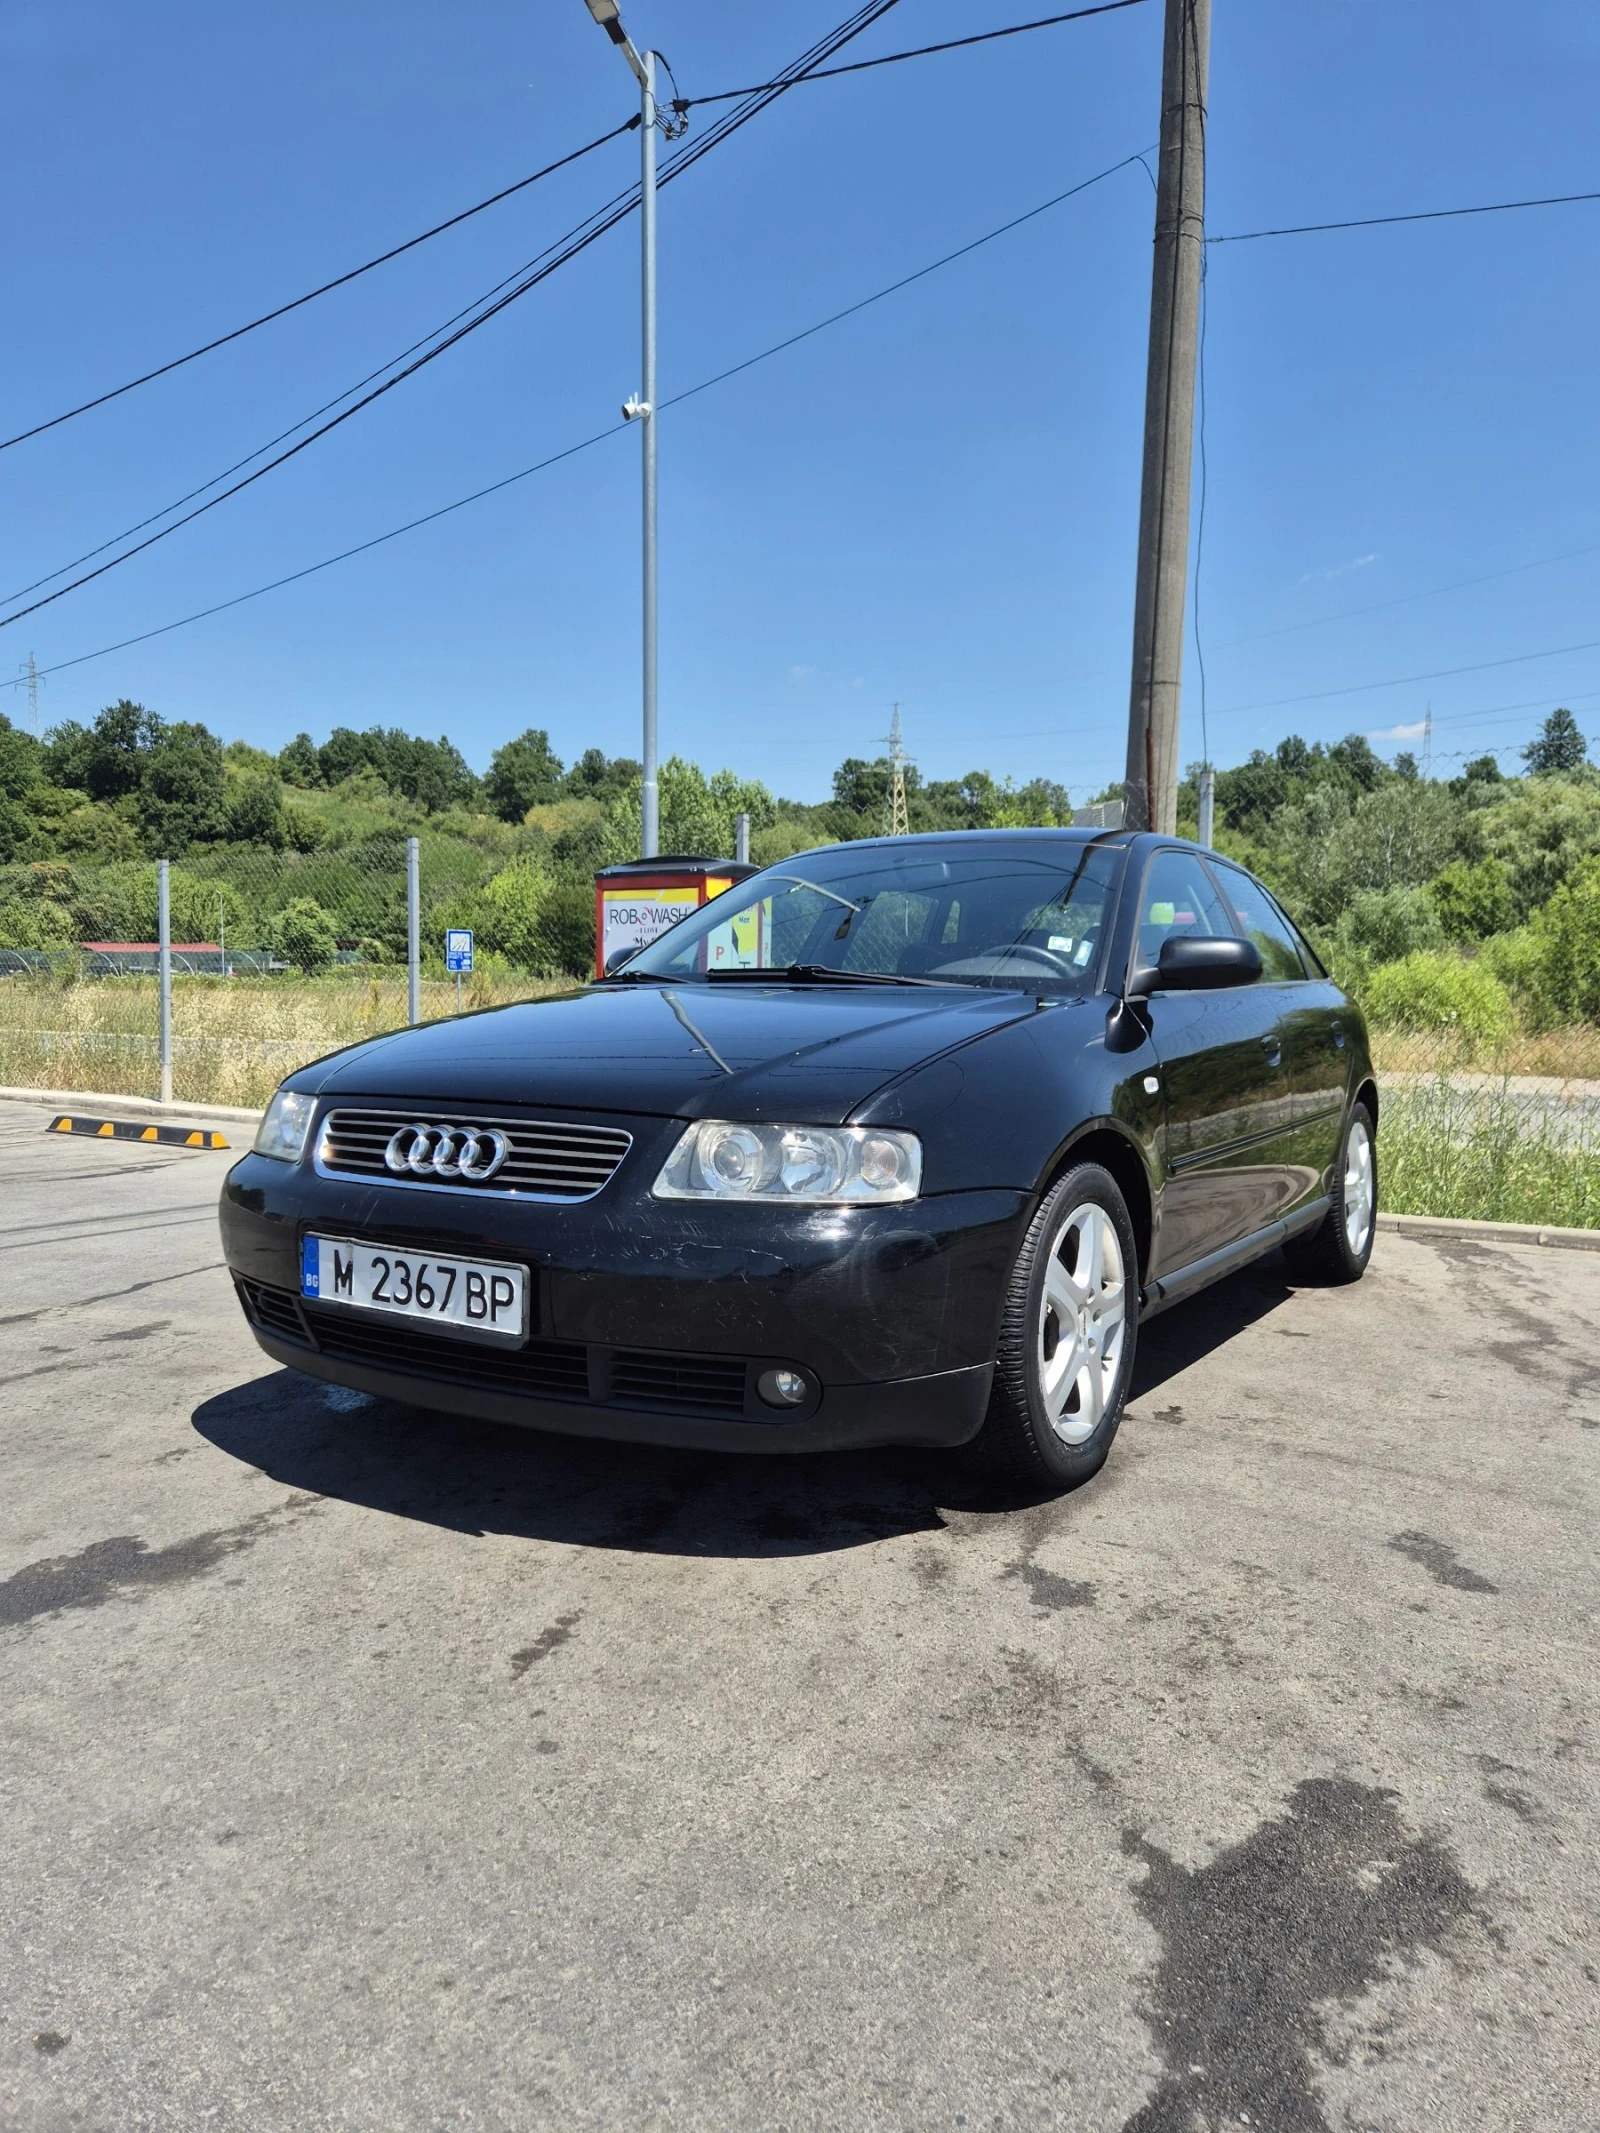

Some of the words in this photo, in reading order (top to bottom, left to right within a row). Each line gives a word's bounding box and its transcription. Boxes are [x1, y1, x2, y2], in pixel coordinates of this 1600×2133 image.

[306, 1273, 319, 1287] BG
[334, 1249, 354, 1296] M
[371, 1256, 457, 1312] 2367
[466, 1271, 515, 1322] BP
